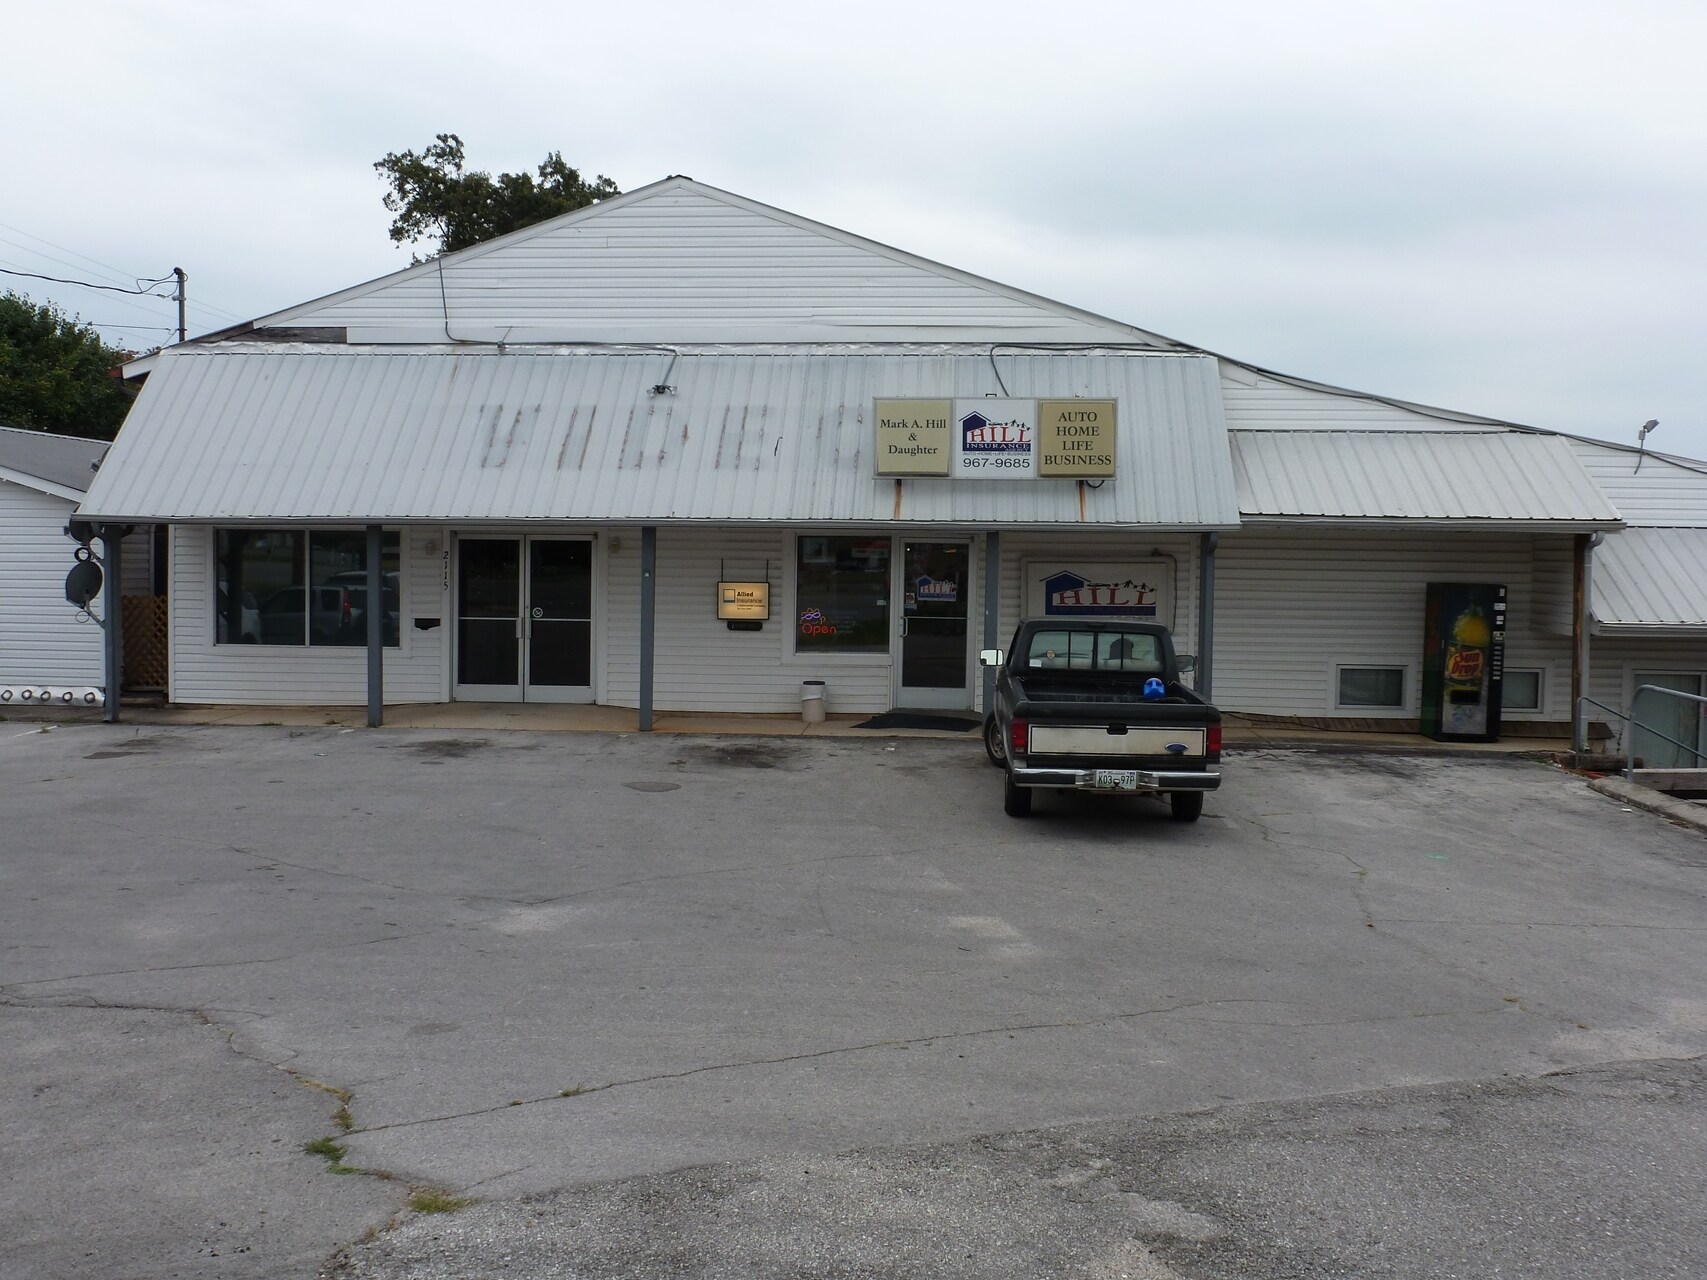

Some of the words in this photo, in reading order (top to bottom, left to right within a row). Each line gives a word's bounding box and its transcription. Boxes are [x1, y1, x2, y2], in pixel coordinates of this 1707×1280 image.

[1058, 411, 1098, 422] AUTO
[880, 418, 909, 429] Mark
[911, 418, 923, 429] A.
[925, 418, 947, 429] Hill
[908, 432, 918, 442] &
[969, 425, 1032, 443] HILL
[1056, 425, 1100, 437] HOME
[888, 444, 938, 457] Daughter
[1062, 440, 1094, 451] LIFE
[963, 457, 1031, 469] 967-9685
[1044, 454, 1112, 466] BUSINESS
[1057, 587, 1157, 606] HILL
[802, 623, 837, 637] Open
[1454, 650, 1480, 662] Sun
[1452, 662, 1481, 676] Drop
